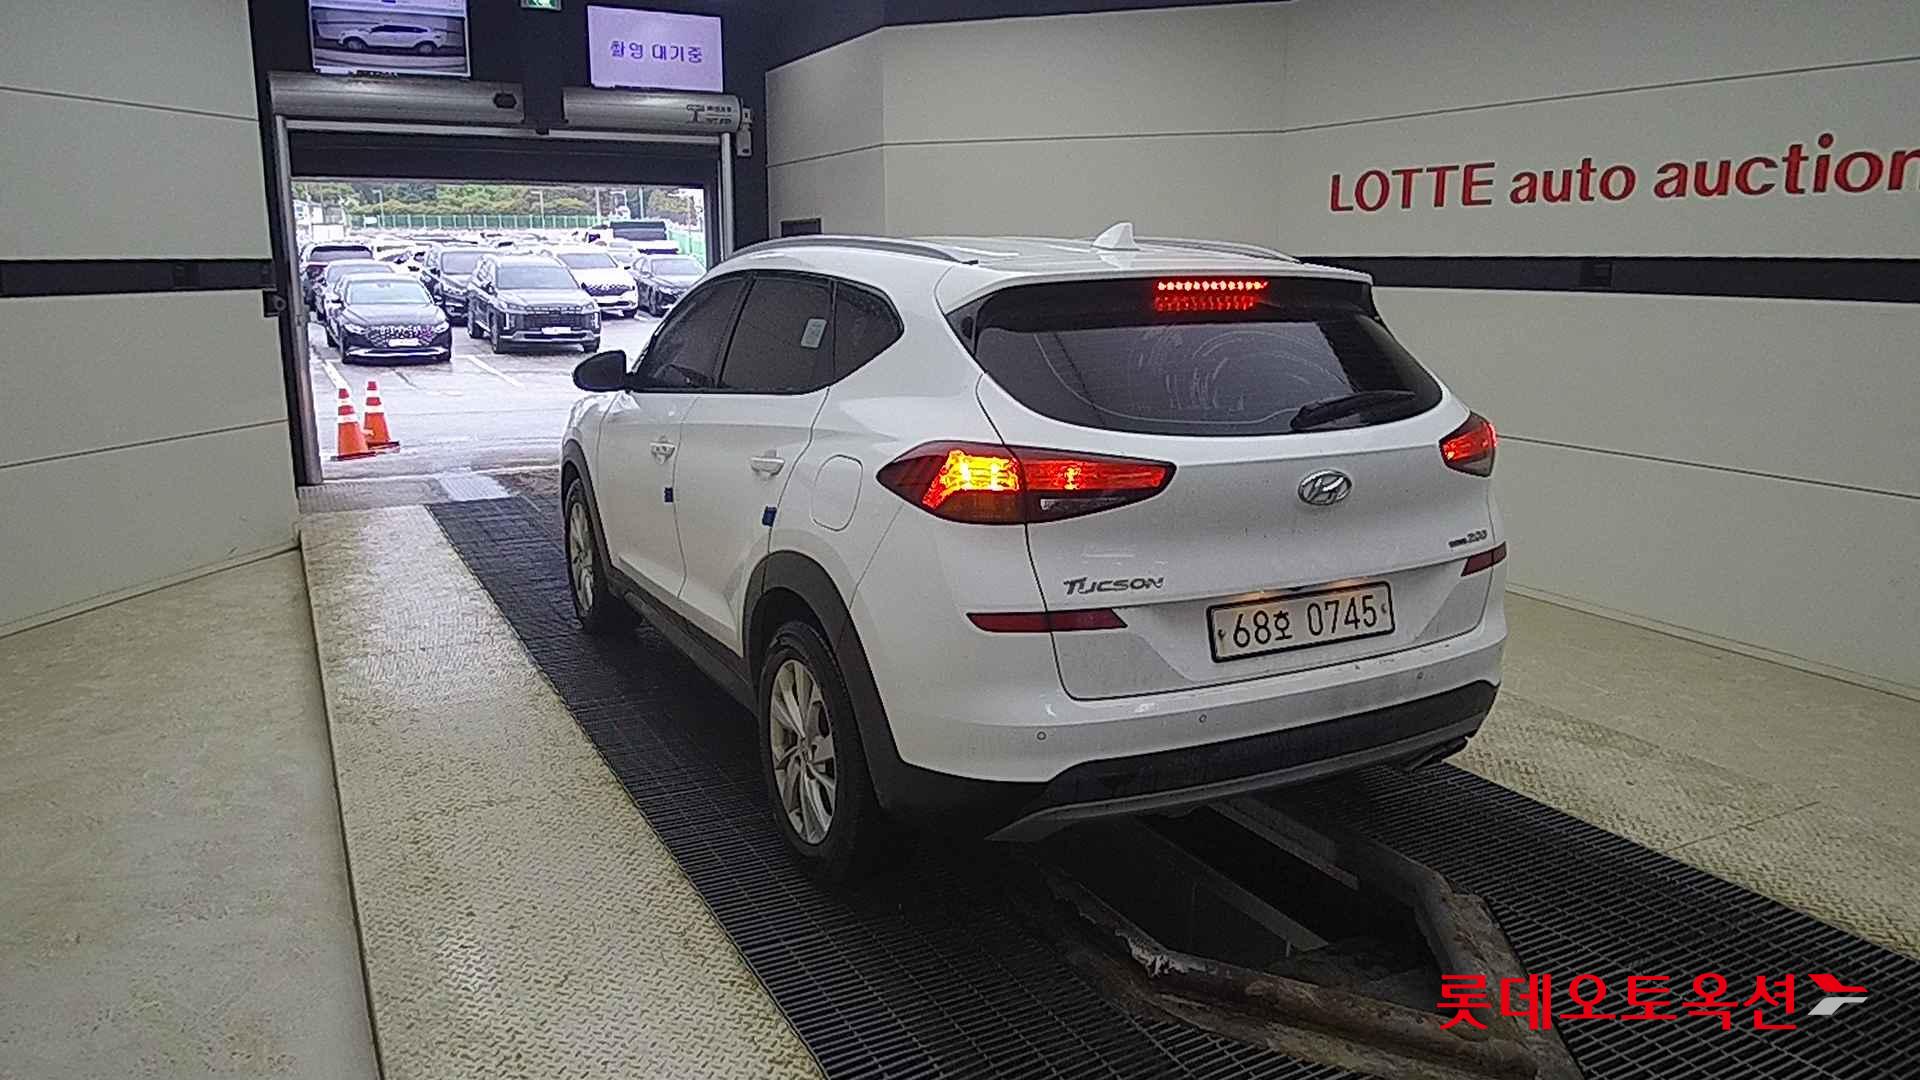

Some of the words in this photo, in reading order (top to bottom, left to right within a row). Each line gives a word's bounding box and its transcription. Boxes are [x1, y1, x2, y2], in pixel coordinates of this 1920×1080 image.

[610, 40, 643, 59] 촬영
[651, 44, 702, 63] 대기중
[1331, 162, 1495, 211] LOTTE
[1510, 157, 1636, 203] auto
[1063, 577, 1164, 595] TUCSON
[1233, 610, 1292, 647] 68호
[1308, 595, 1377, 636] 0745
